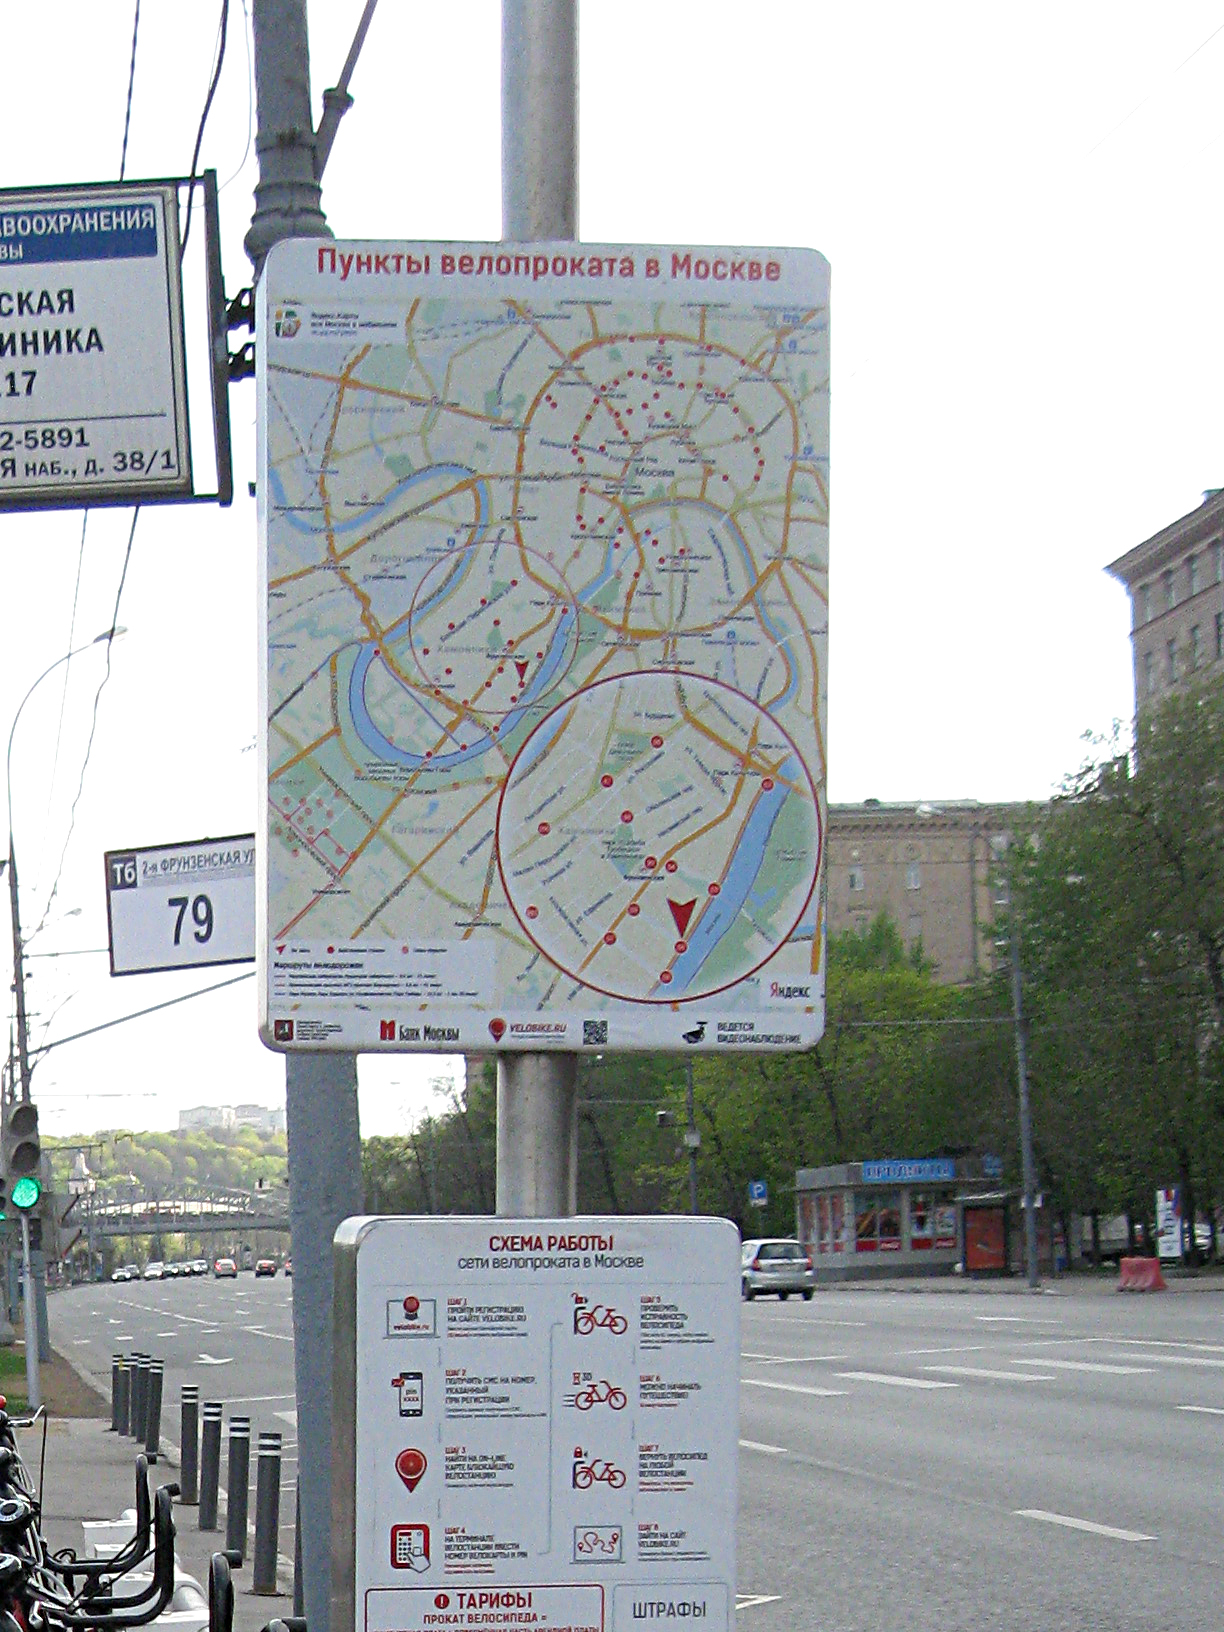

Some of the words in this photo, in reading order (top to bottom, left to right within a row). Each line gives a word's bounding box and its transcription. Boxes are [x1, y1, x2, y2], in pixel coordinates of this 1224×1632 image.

[317, 247, 431, 280] Пункты
[440, 254, 635, 284] велопроката
[646, 259, 660, 279] в
[671, 254, 782, 281] Москве
[112, 448, 176, 473] 38/1
[142, 860, 158, 875] 2-я
[160, 850, 241, 872] ФРУНЗЕНСКАЯ
[168, 894, 214, 946] 79
[770, 981, 811, 999] Яндекс
[399, 1025, 421, 1041] Банк
[423, 1025, 460, 1041] Москвы
[489, 1235, 544, 1252] СХЕМА
[547, 1234, 614, 1252] РАБОТЫ
[457, 1255, 490, 1270] сети
[492, 1256, 581, 1272] велопроката
[583, 1257, 592, 1268] в
[594, 1254, 645, 1269] Москве
[457, 1592, 532, 1609] ТАРИФЫ
[423, 1614, 464, 1625] ПРОКАТ
[467, 1613, 538, 1624] ВЕЛОСИПЕДА
[632, 1601, 707, 1619] ШТРАФЫ
